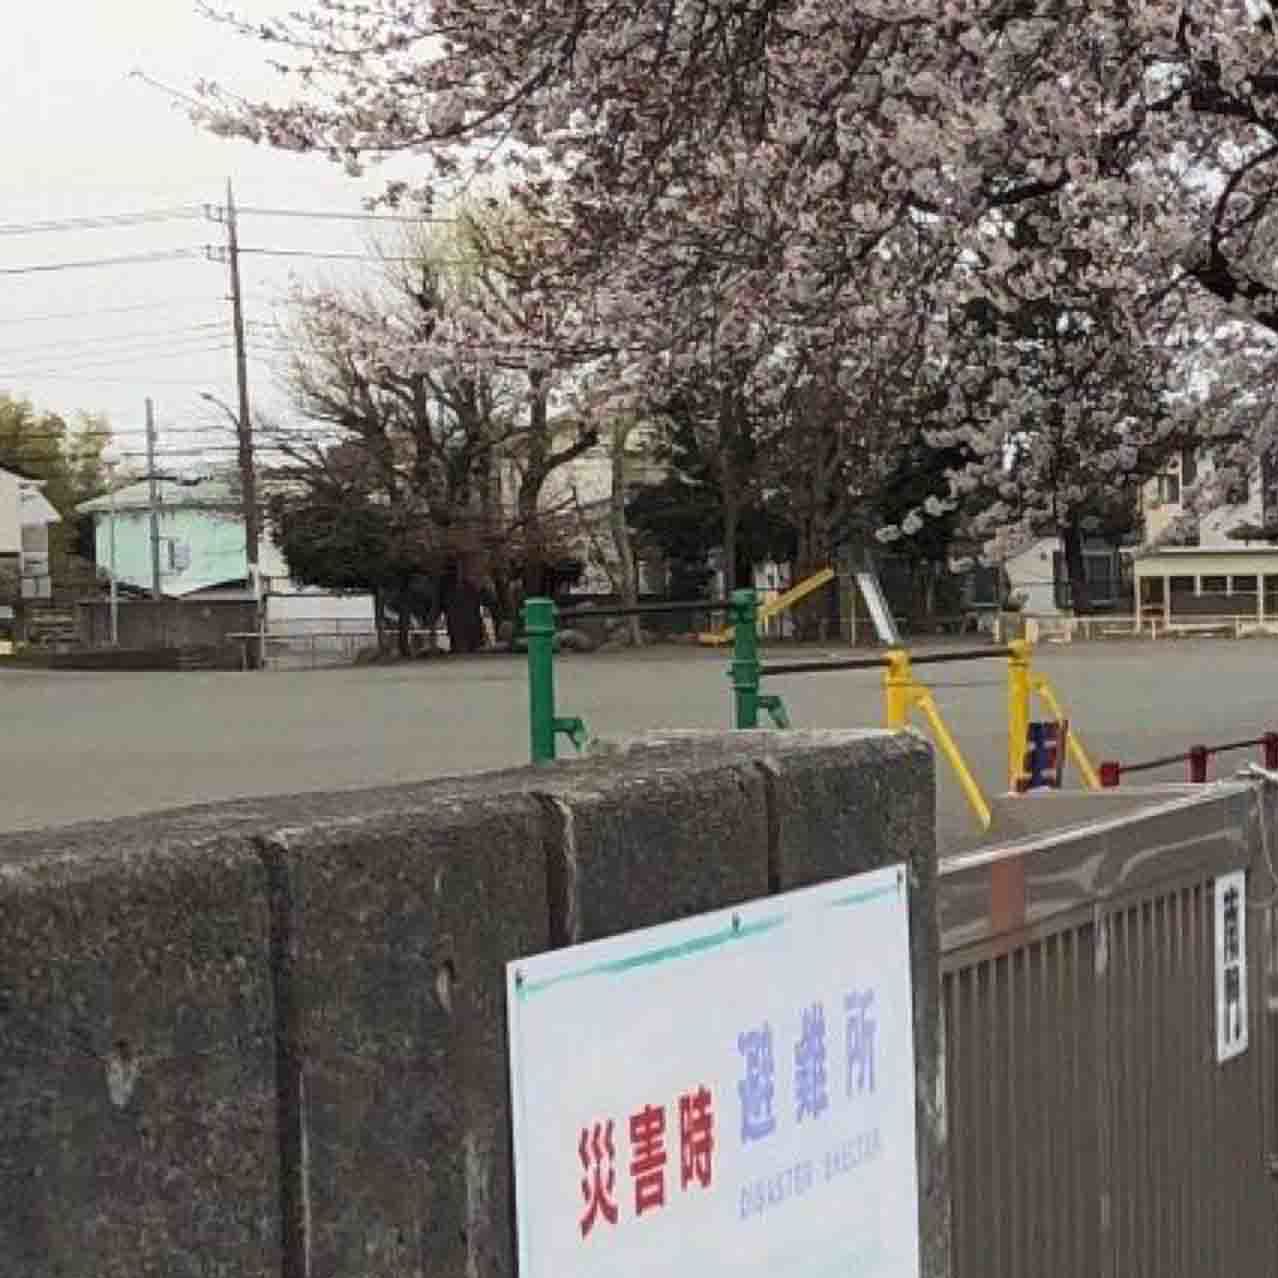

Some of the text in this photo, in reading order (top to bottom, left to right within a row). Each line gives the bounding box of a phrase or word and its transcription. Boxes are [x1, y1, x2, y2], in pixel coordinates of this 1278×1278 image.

[578, 987, 877, 1237] 災害時 避難所
